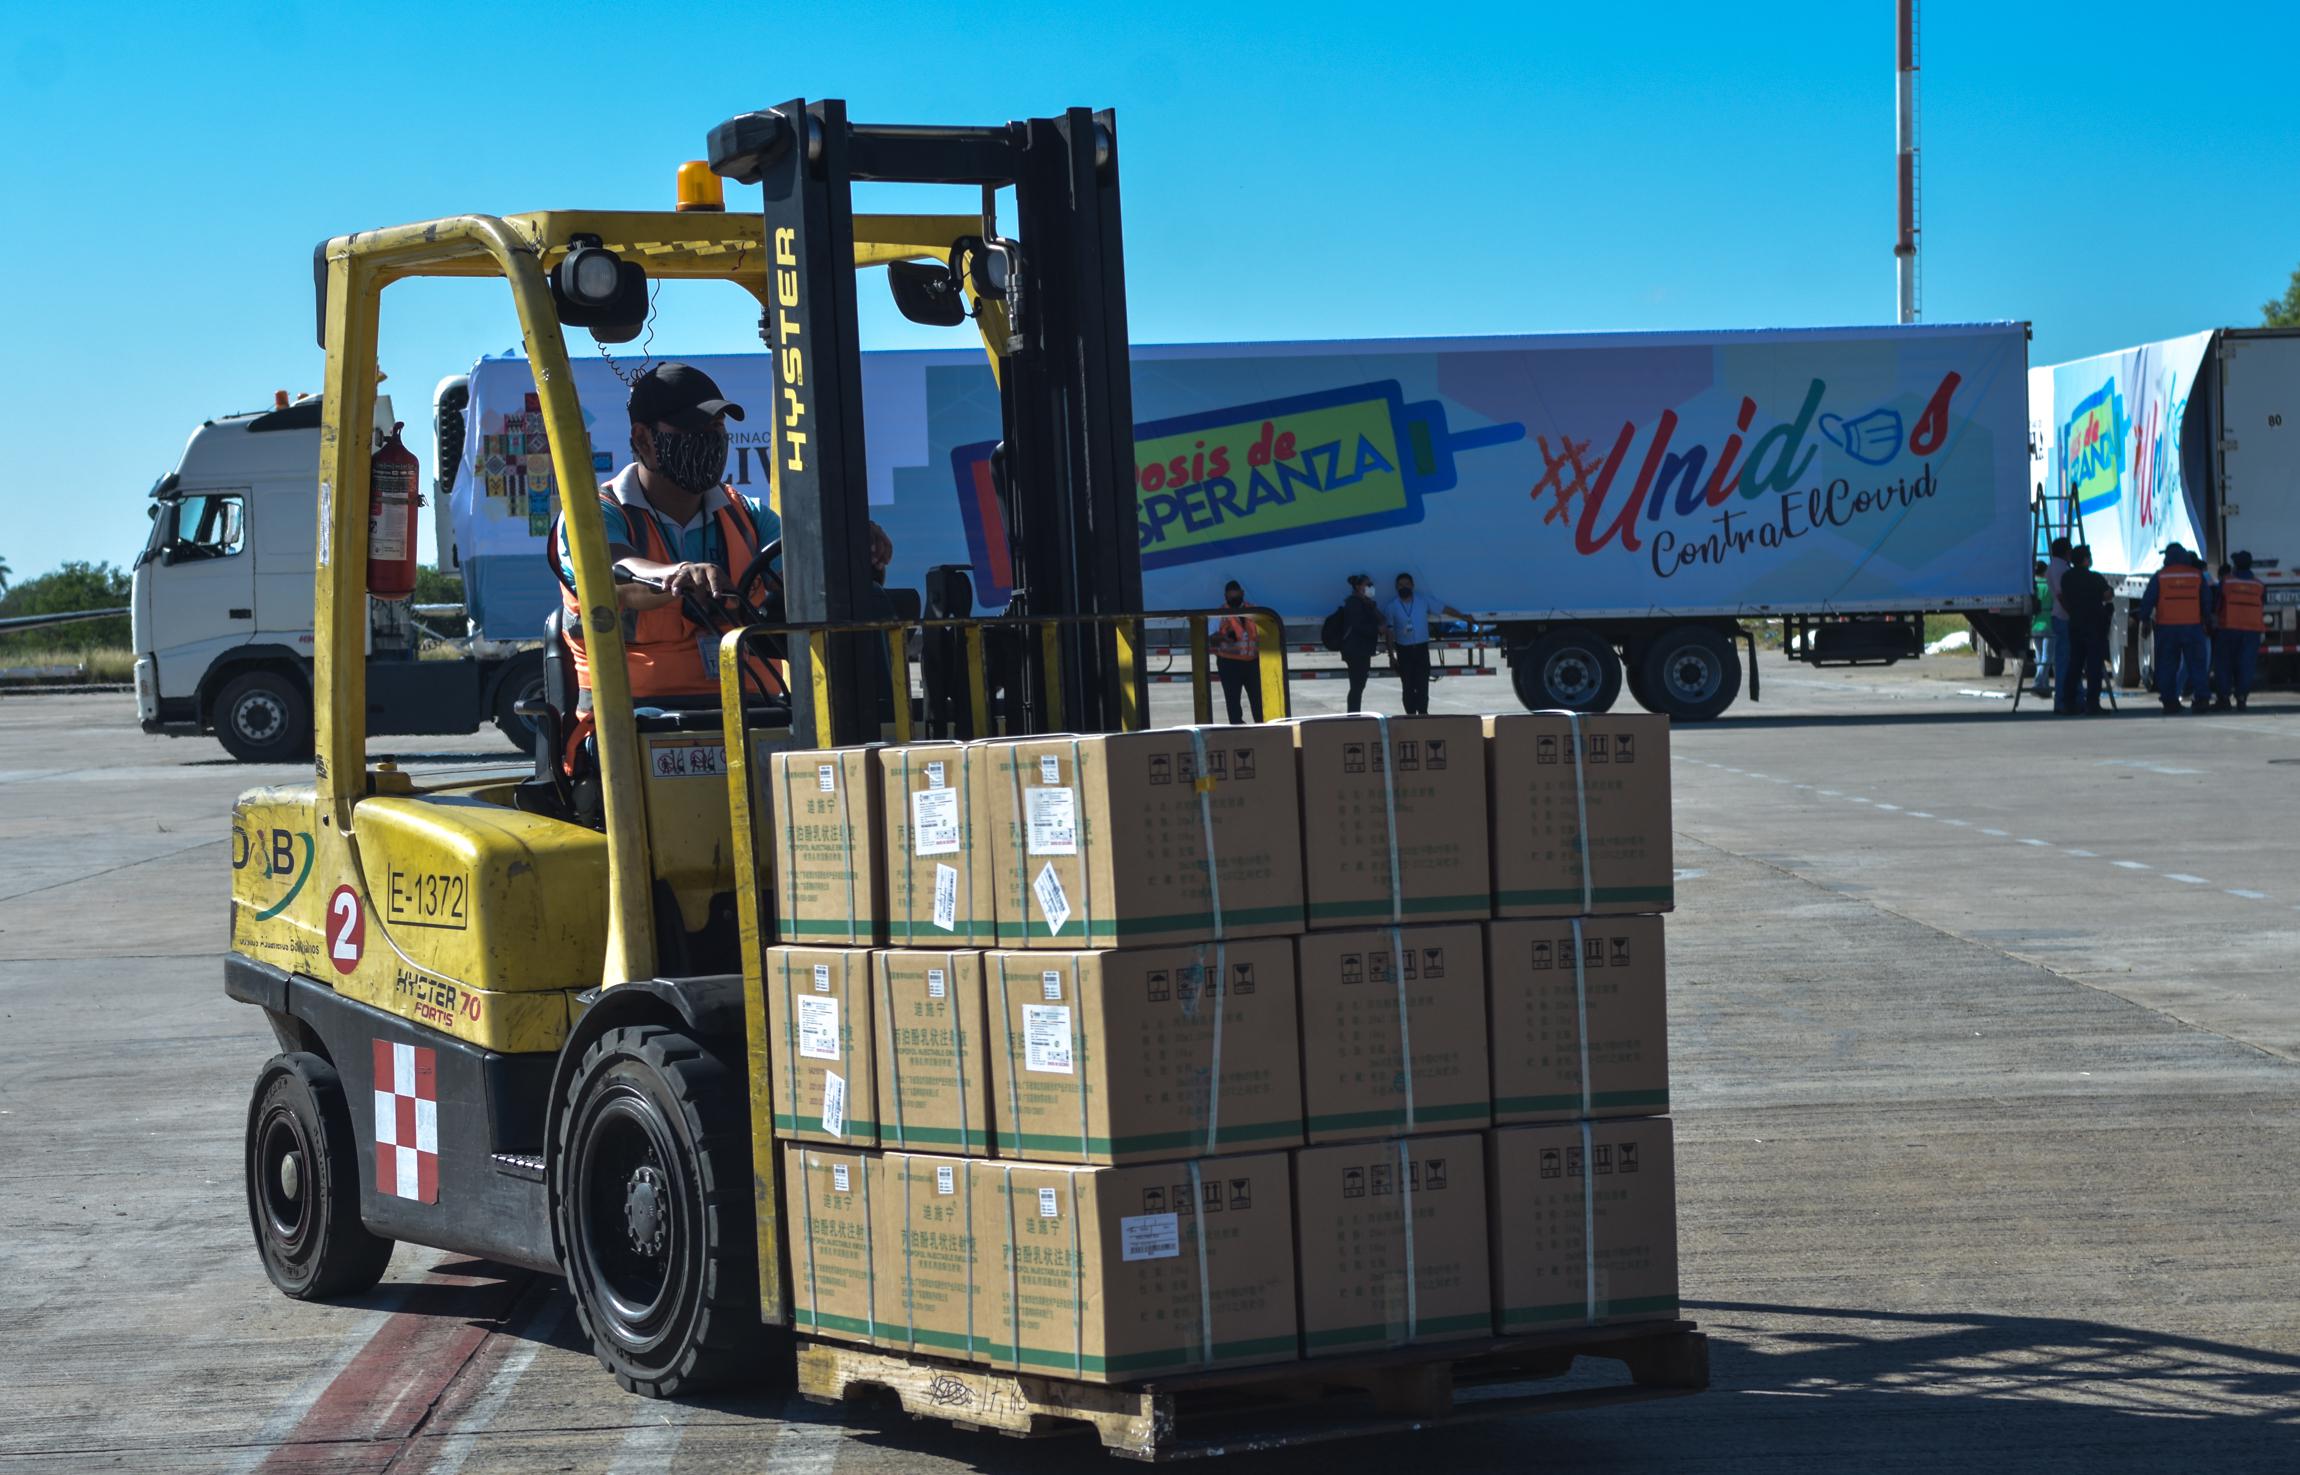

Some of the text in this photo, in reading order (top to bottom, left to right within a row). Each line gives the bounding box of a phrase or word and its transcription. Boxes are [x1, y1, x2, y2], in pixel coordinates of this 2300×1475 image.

[775, 227, 807, 472] HYSTER
[2268, 415, 2282, 428] 80
[1136, 421, 1297, 492] osis de
[1136, 433, 1394, 549] SPERANZA
[391, 872, 464, 918] E-1372
[334, 892, 358, 960] 2
[396, 968, 482, 1022] HYSTER 70
[414, 1002, 455, 1027] FORTIS
